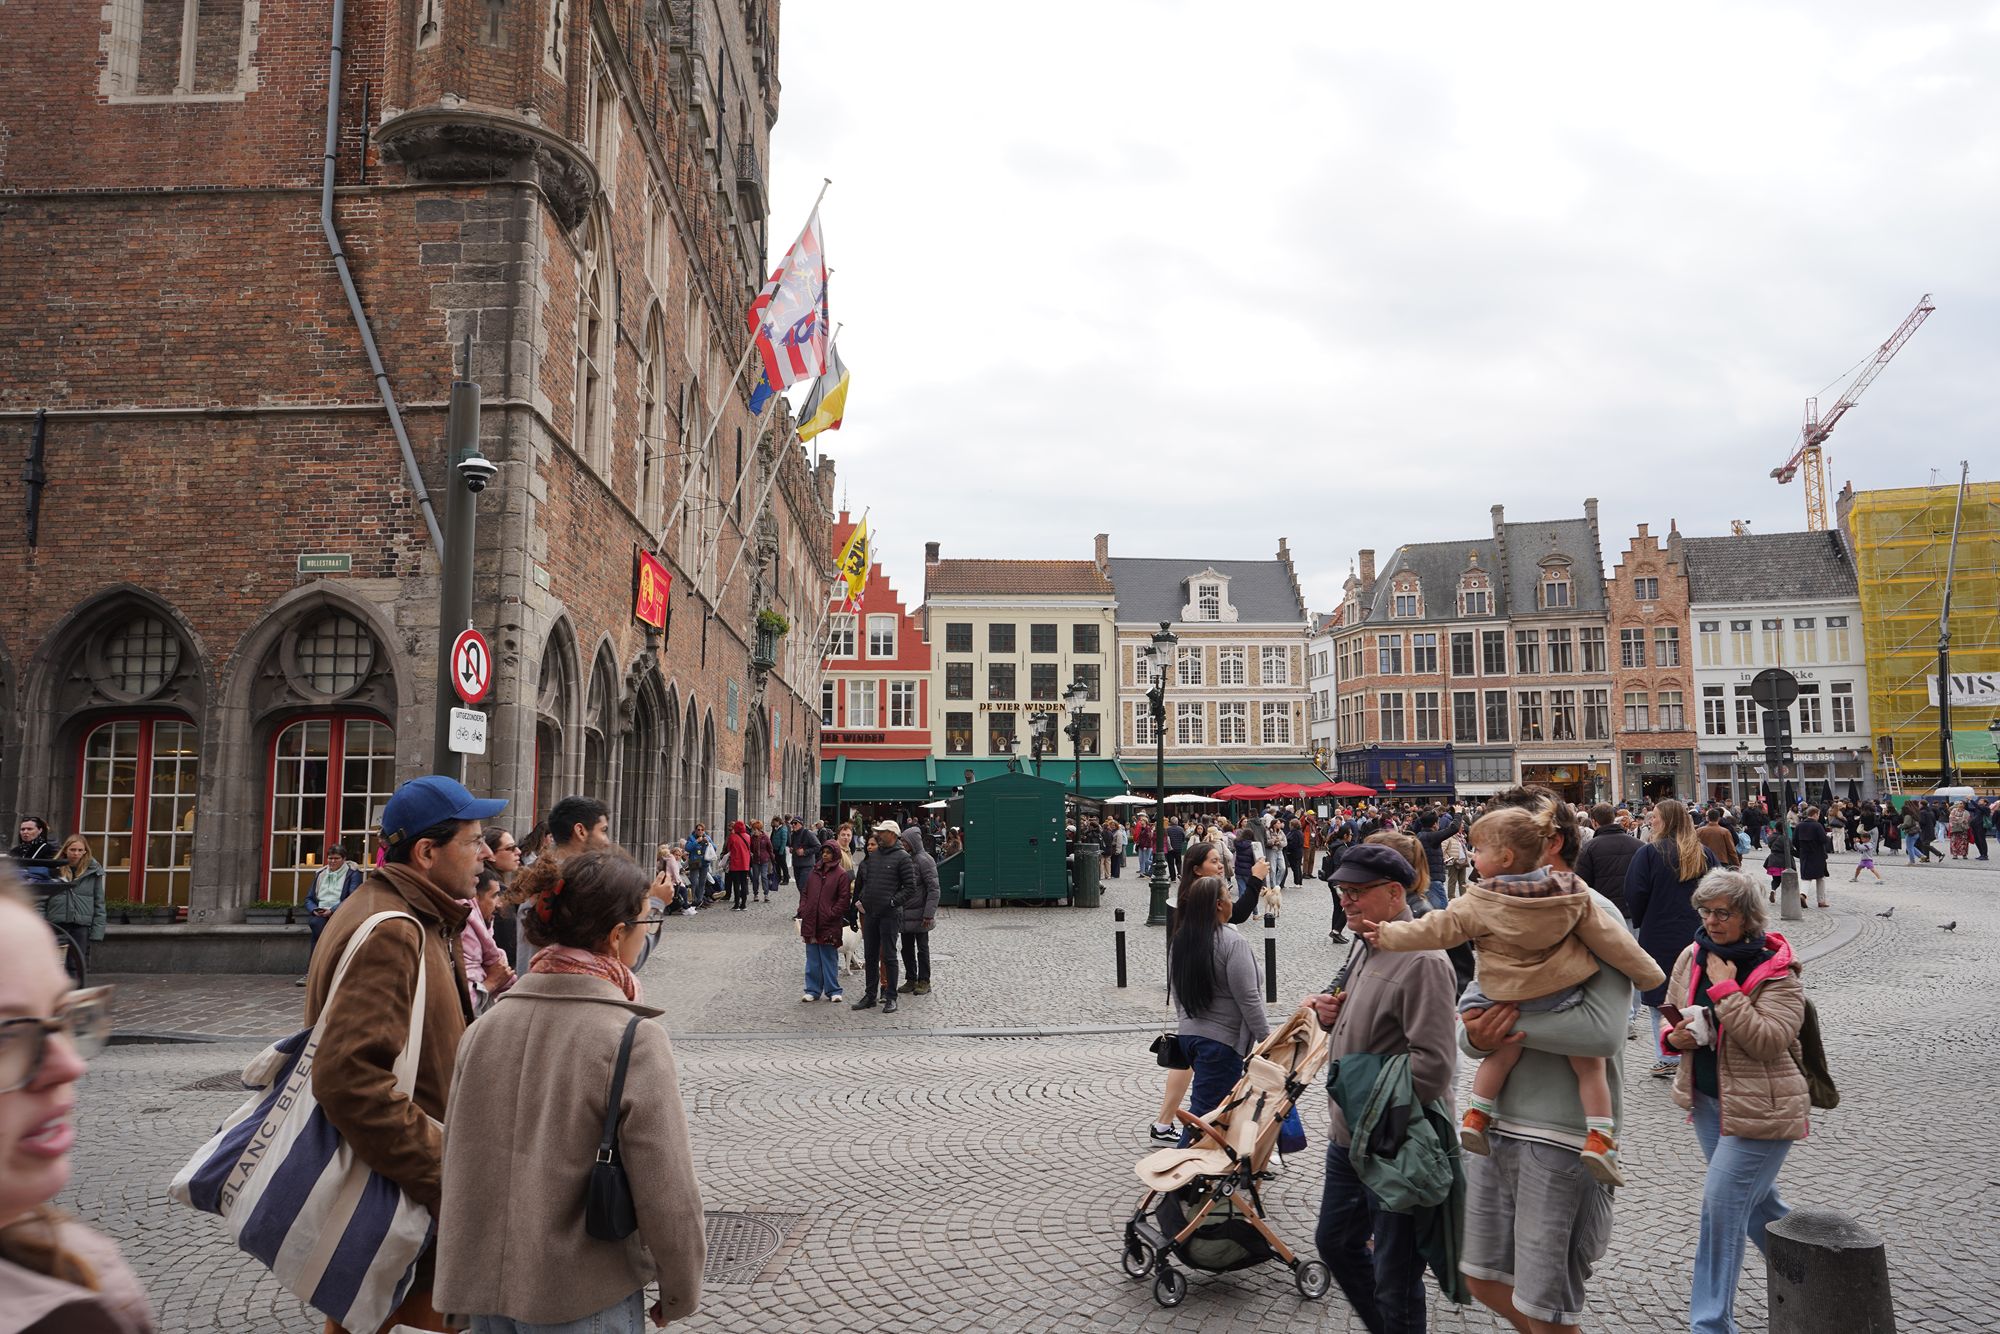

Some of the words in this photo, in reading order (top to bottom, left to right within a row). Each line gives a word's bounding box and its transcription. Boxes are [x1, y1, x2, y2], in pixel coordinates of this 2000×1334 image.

[1792, 671, 1814, 679] kke
[980, 703, 992, 711] DE
[996, 703, 1020, 711] VIER
[1024, 703, 1066, 711] WINDEN
[843, 733, 885, 744] WINDEN
[1816, 753, 1835, 761] 1954
[222, 1121, 277, 1208] BLANC
